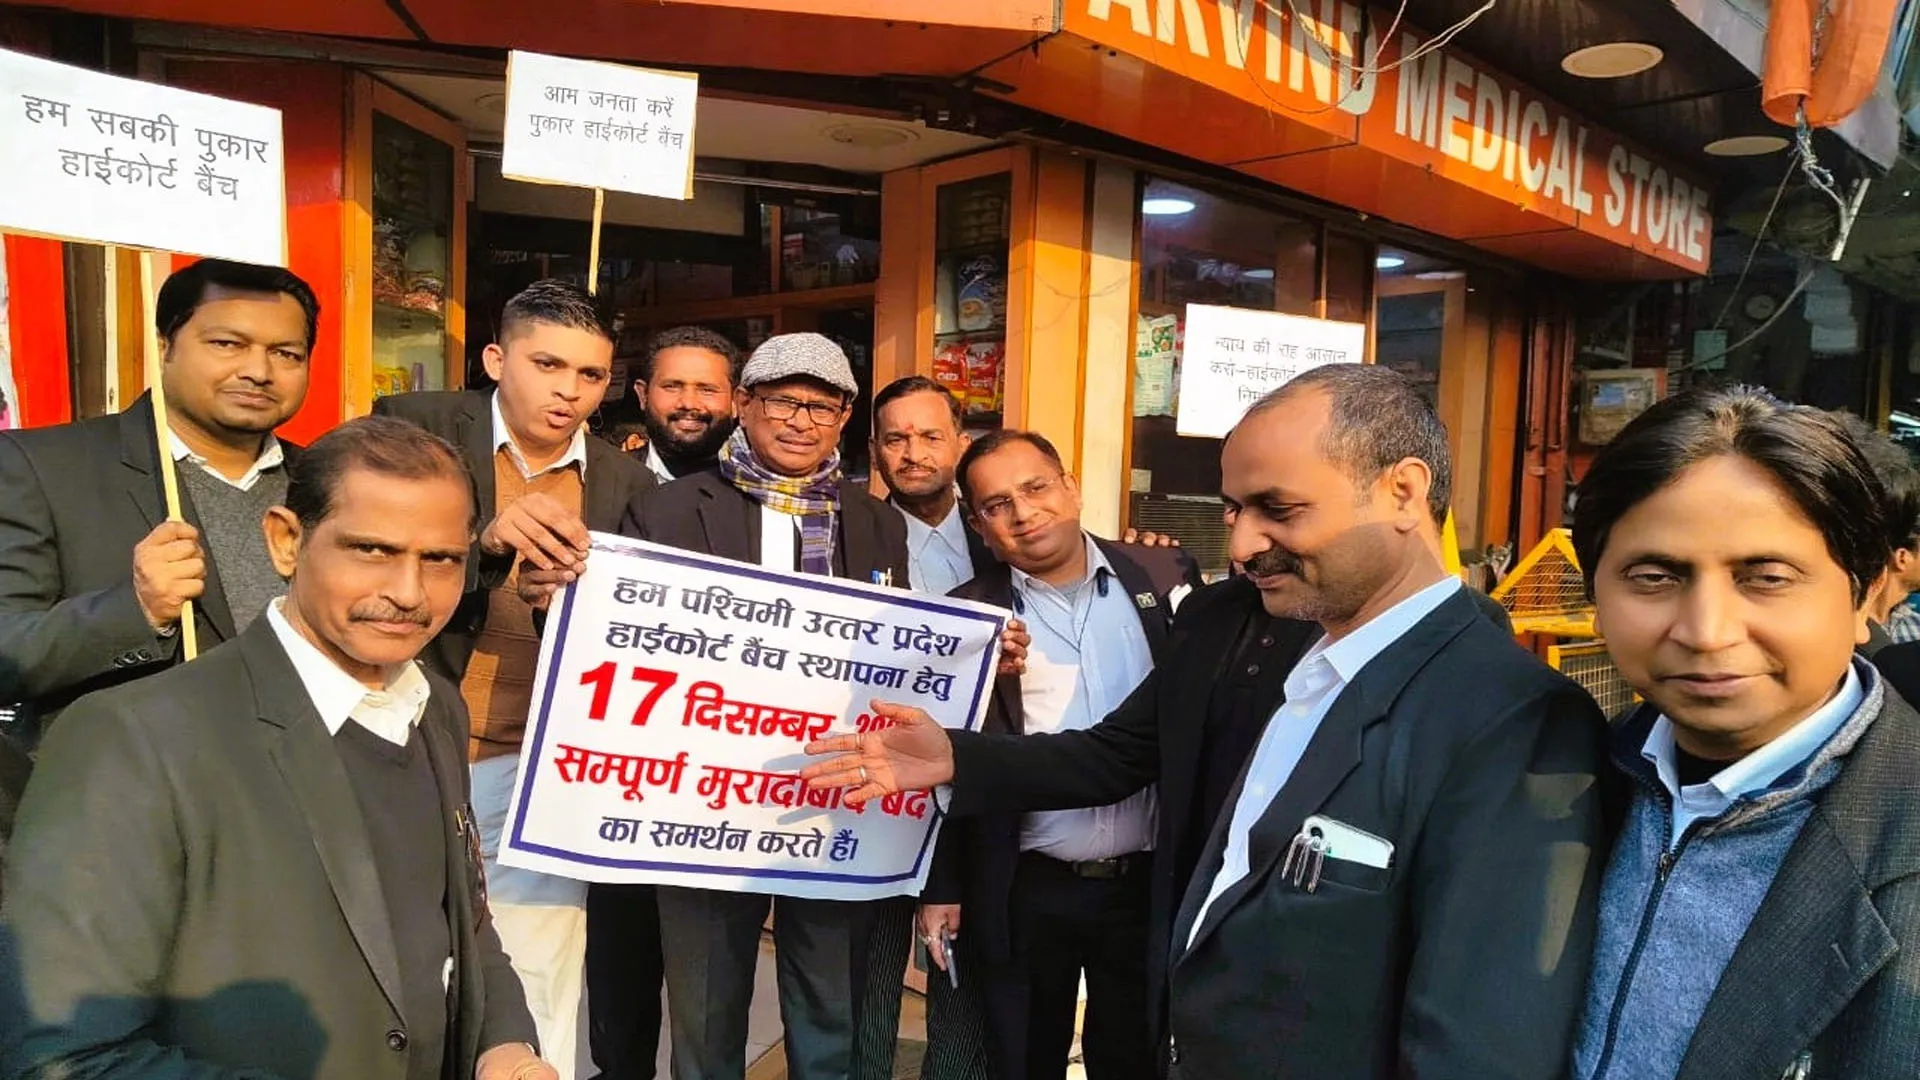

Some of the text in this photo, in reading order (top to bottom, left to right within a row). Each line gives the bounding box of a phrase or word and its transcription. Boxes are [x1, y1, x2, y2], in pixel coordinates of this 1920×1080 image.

[21, 95, 269, 165] हम सबकी पुकार
[529, 114, 574, 137] पुकार
[584, 117, 648, 143] हाईकोर्ट
[544, 86, 674, 118] आम जनता करें
[58, 145, 239, 200] हाईकोर्ट बैंच
[1395, 32, 1593, 216] MEDICAL
[1604, 145, 1709, 262] STORE
[1216, 337, 1349, 363] न्याय की राह आसान
[613, 577, 962, 657] हम पश्चिमी उत्तर प्रदेश
[605, 621, 956, 701] हाईकोर्ट बैंच स्थापना हेतु
[580, 661, 677, 726] 17
[682, 681, 836, 742] दिसम्बर
[554, 744, 688, 801] सम्पूर्ण
[599, 816, 643, 843] का
[650, 821, 752, 853] समर्थन
[757, 827, 825, 858] करते
